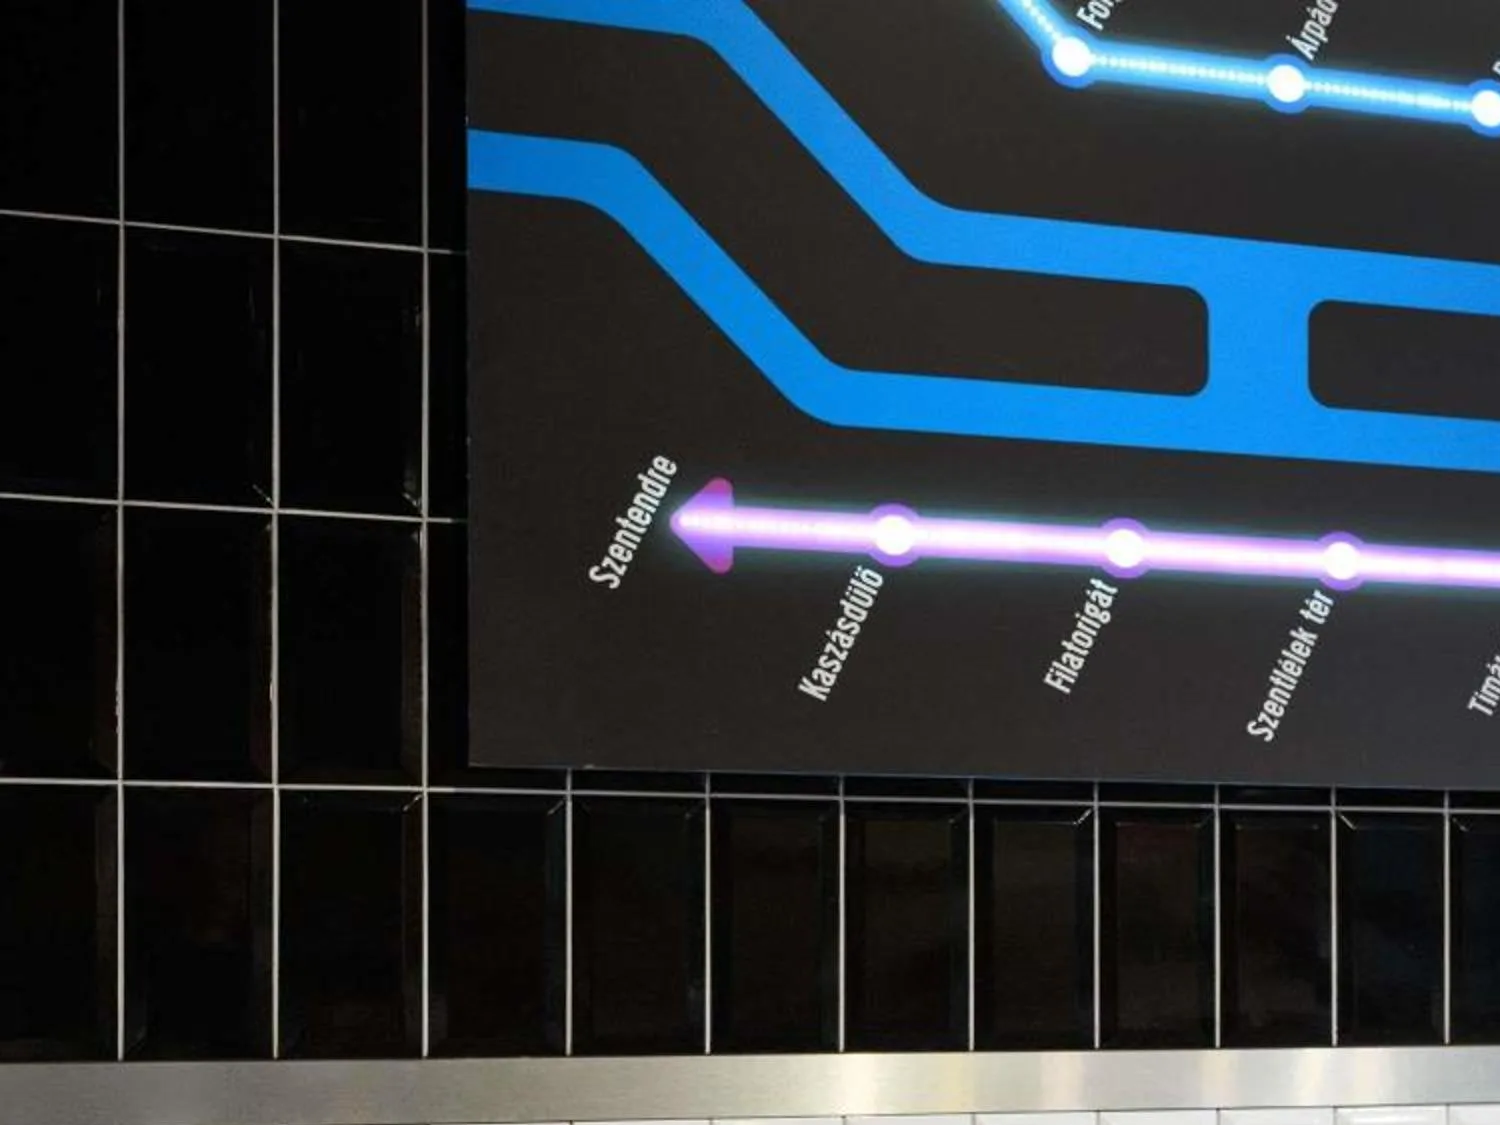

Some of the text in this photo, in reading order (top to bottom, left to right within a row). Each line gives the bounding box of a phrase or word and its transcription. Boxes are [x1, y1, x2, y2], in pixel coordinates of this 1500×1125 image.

[589, 454, 678, 590] Szentendre
[1043, 577, 1118, 694] Filatorigát
[1247, 589, 1334, 741] Szentlélek tér
